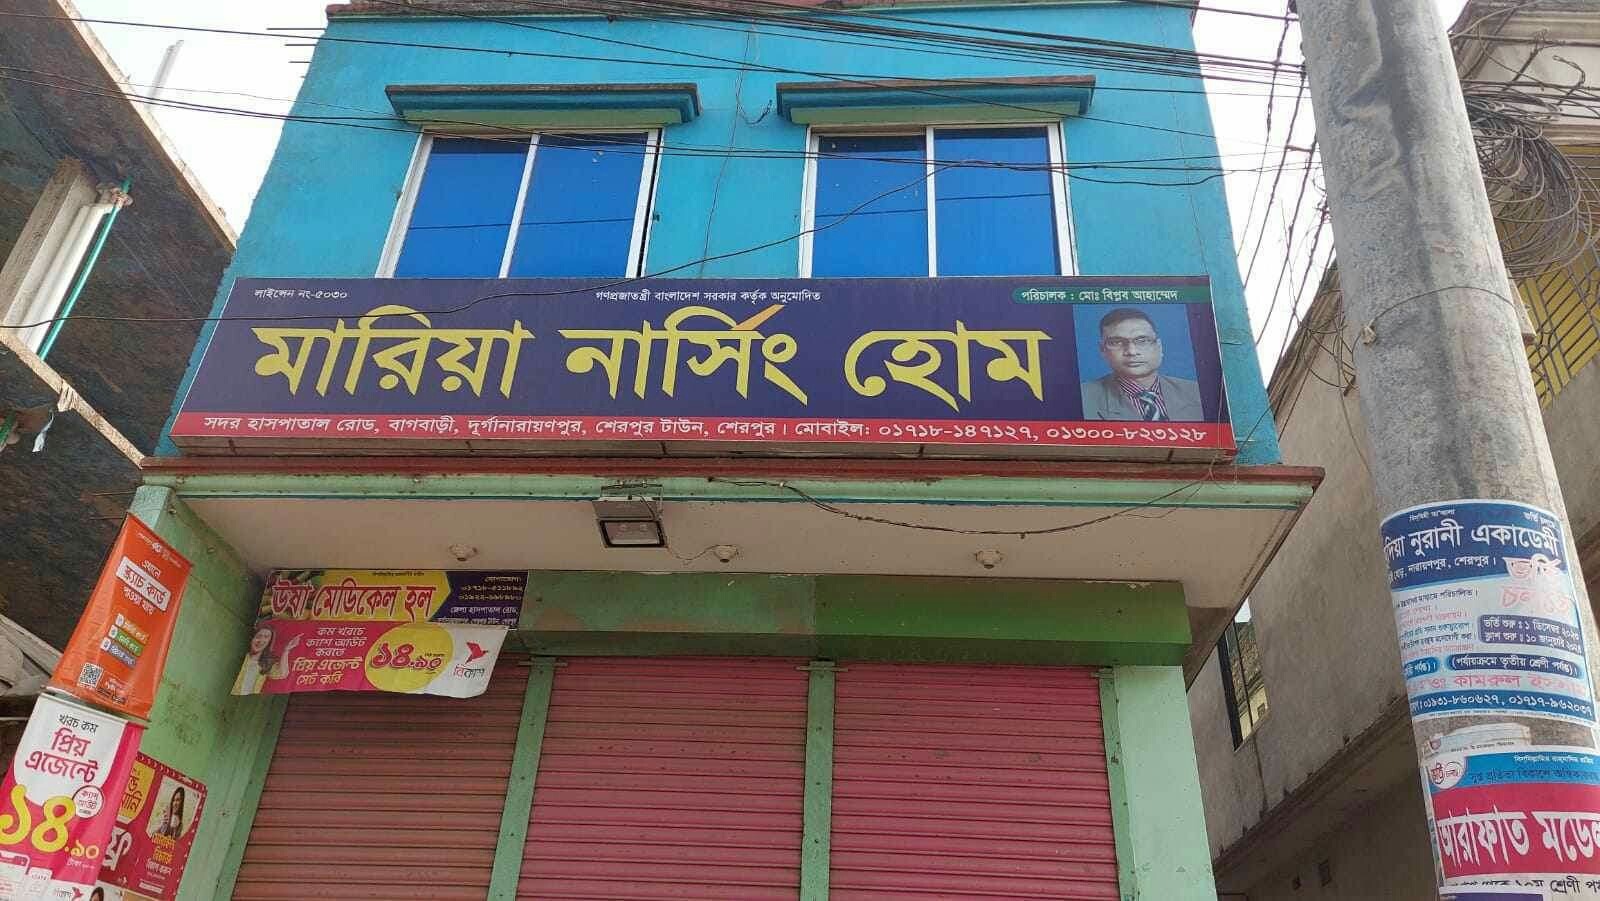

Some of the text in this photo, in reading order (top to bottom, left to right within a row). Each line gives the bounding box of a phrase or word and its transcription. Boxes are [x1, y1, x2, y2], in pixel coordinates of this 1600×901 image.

[655, 290, 699, 301] বাংলাদেশ
[703, 291, 736, 301] সরকার
[740, 289, 767, 304] কর্তৃক
[770, 288, 821, 303] অনুমোদিত
[1021, 288, 1066, 301] পরিচালক
[1102, 287, 1129, 301] বিপ্লব
[250, 303, 1053, 413] মারিয়া নার্সিং হোম
[204, 416, 242, 431] সদর
[247, 416, 331, 432] হাসপাতাল
[336, 418, 380, 434] রোড,
[388, 414, 459, 434] বাগবাড়ী,
[595, 418, 654, 437] শেরপুর
[660, 418, 710, 437] টাউন,
[717, 421, 776, 438] শেরপুর
[794, 418, 870, 437] মোবাইল:
[878, 422, 1039, 442] ০১৭১৮-১৪৭১২৭,
[1046, 427, 1208, 443] ০১৩০০-৮২৩১২৮
[1408, 518, 1464, 557] নুরানী
[1470, 525, 1560, 558] একাডেমী
[313, 577, 402, 618] মেডিকেল
[370, 641, 443, 670] ১৪.৯০
[59, 713, 99, 734] খরচ কম
[51, 727, 91, 757] প্রিয়
[24, 750, 100, 784] এজেন্টে
